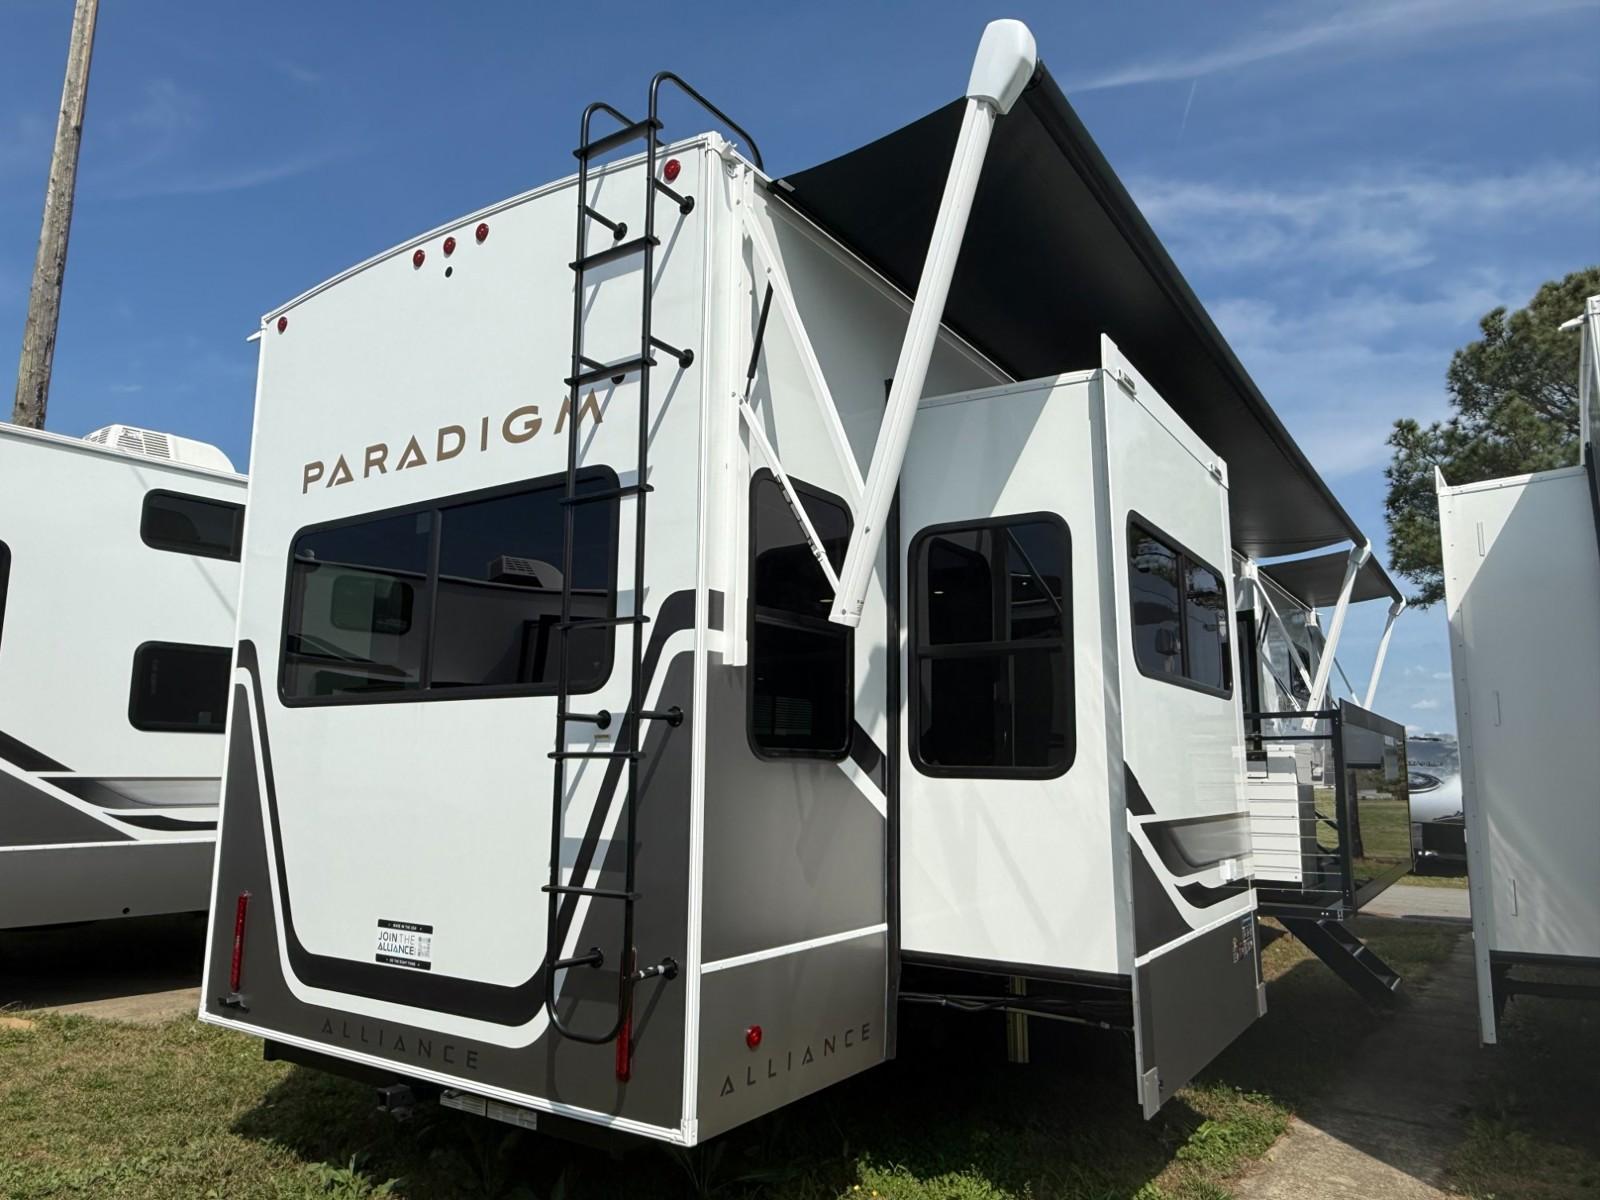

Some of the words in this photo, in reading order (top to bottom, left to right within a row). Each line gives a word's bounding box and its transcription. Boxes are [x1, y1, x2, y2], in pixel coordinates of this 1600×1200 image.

[302, 387, 603, 494] PARADIGM
[377, 941, 414, 956] ALLIANCE
[378, 930, 398, 943] JOIN
[400, 933, 415, 946] THE
[321, 1017, 479, 1070] ALLIANCE
[720, 1022, 871, 1096] ALLIANCE
